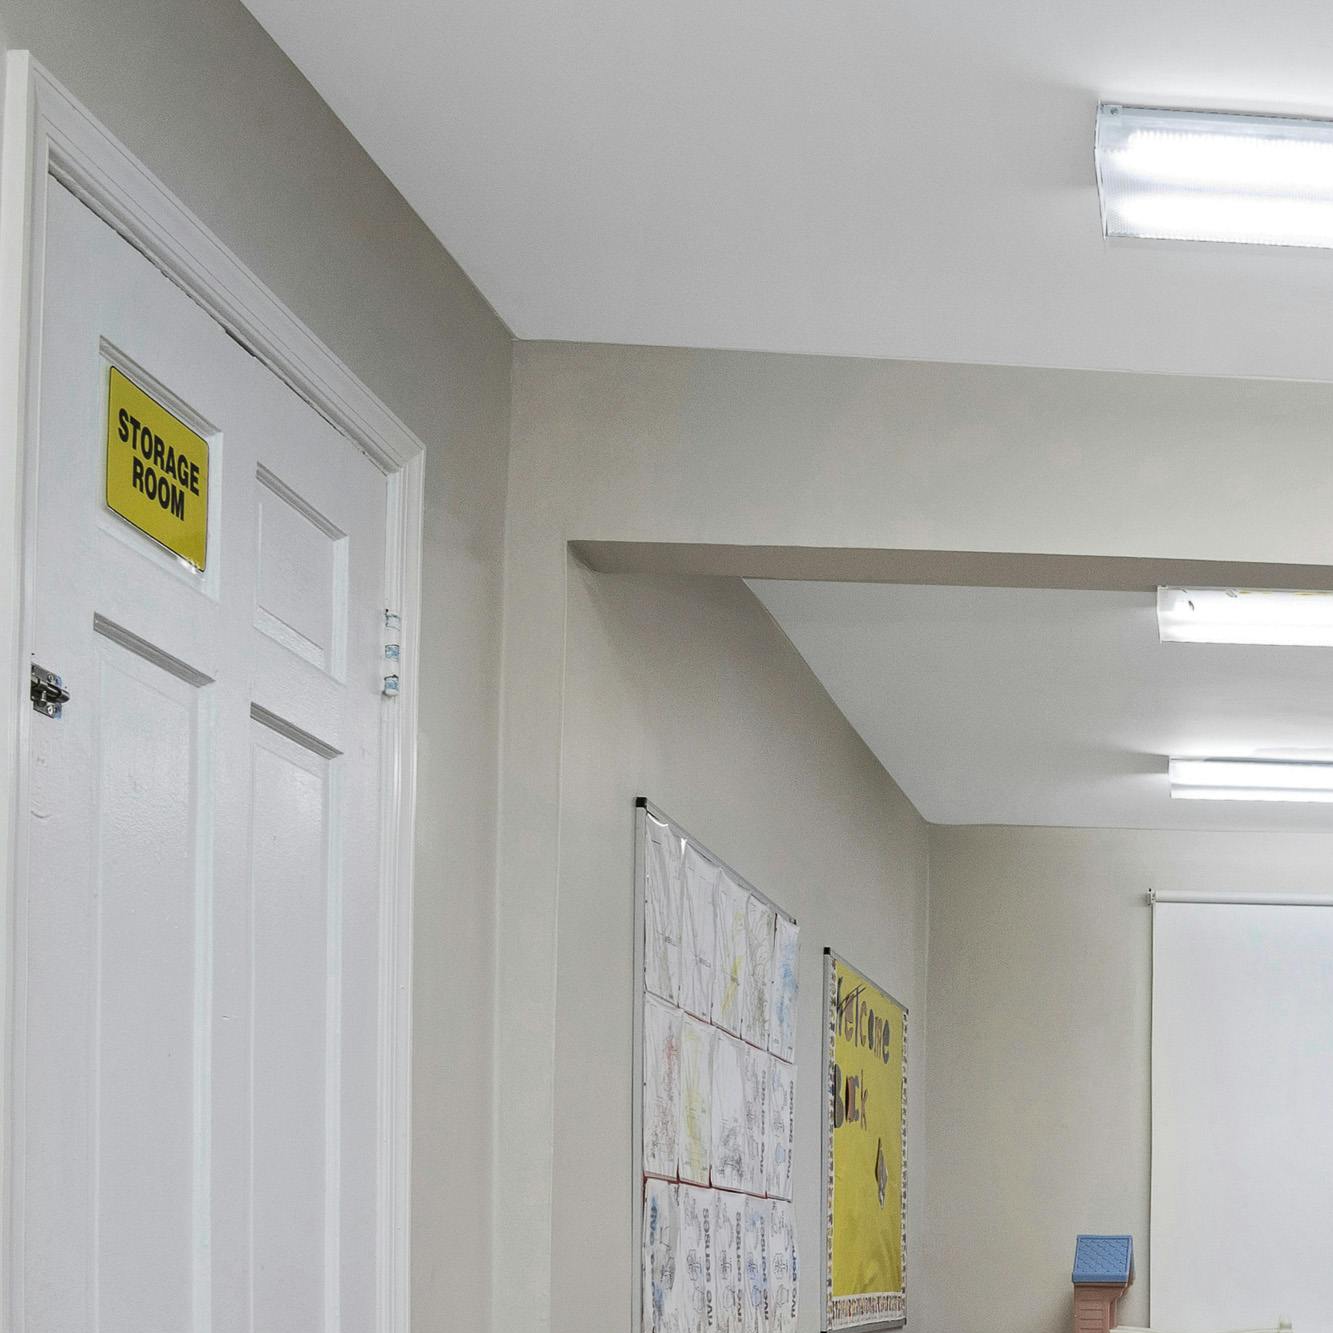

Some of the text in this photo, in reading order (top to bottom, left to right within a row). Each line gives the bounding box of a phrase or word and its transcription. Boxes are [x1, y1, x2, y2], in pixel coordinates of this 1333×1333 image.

[117, 407, 201, 497] STORAGE
[132, 455, 185, 522] ROOM
[835, 975, 891, 1065] Welcome
